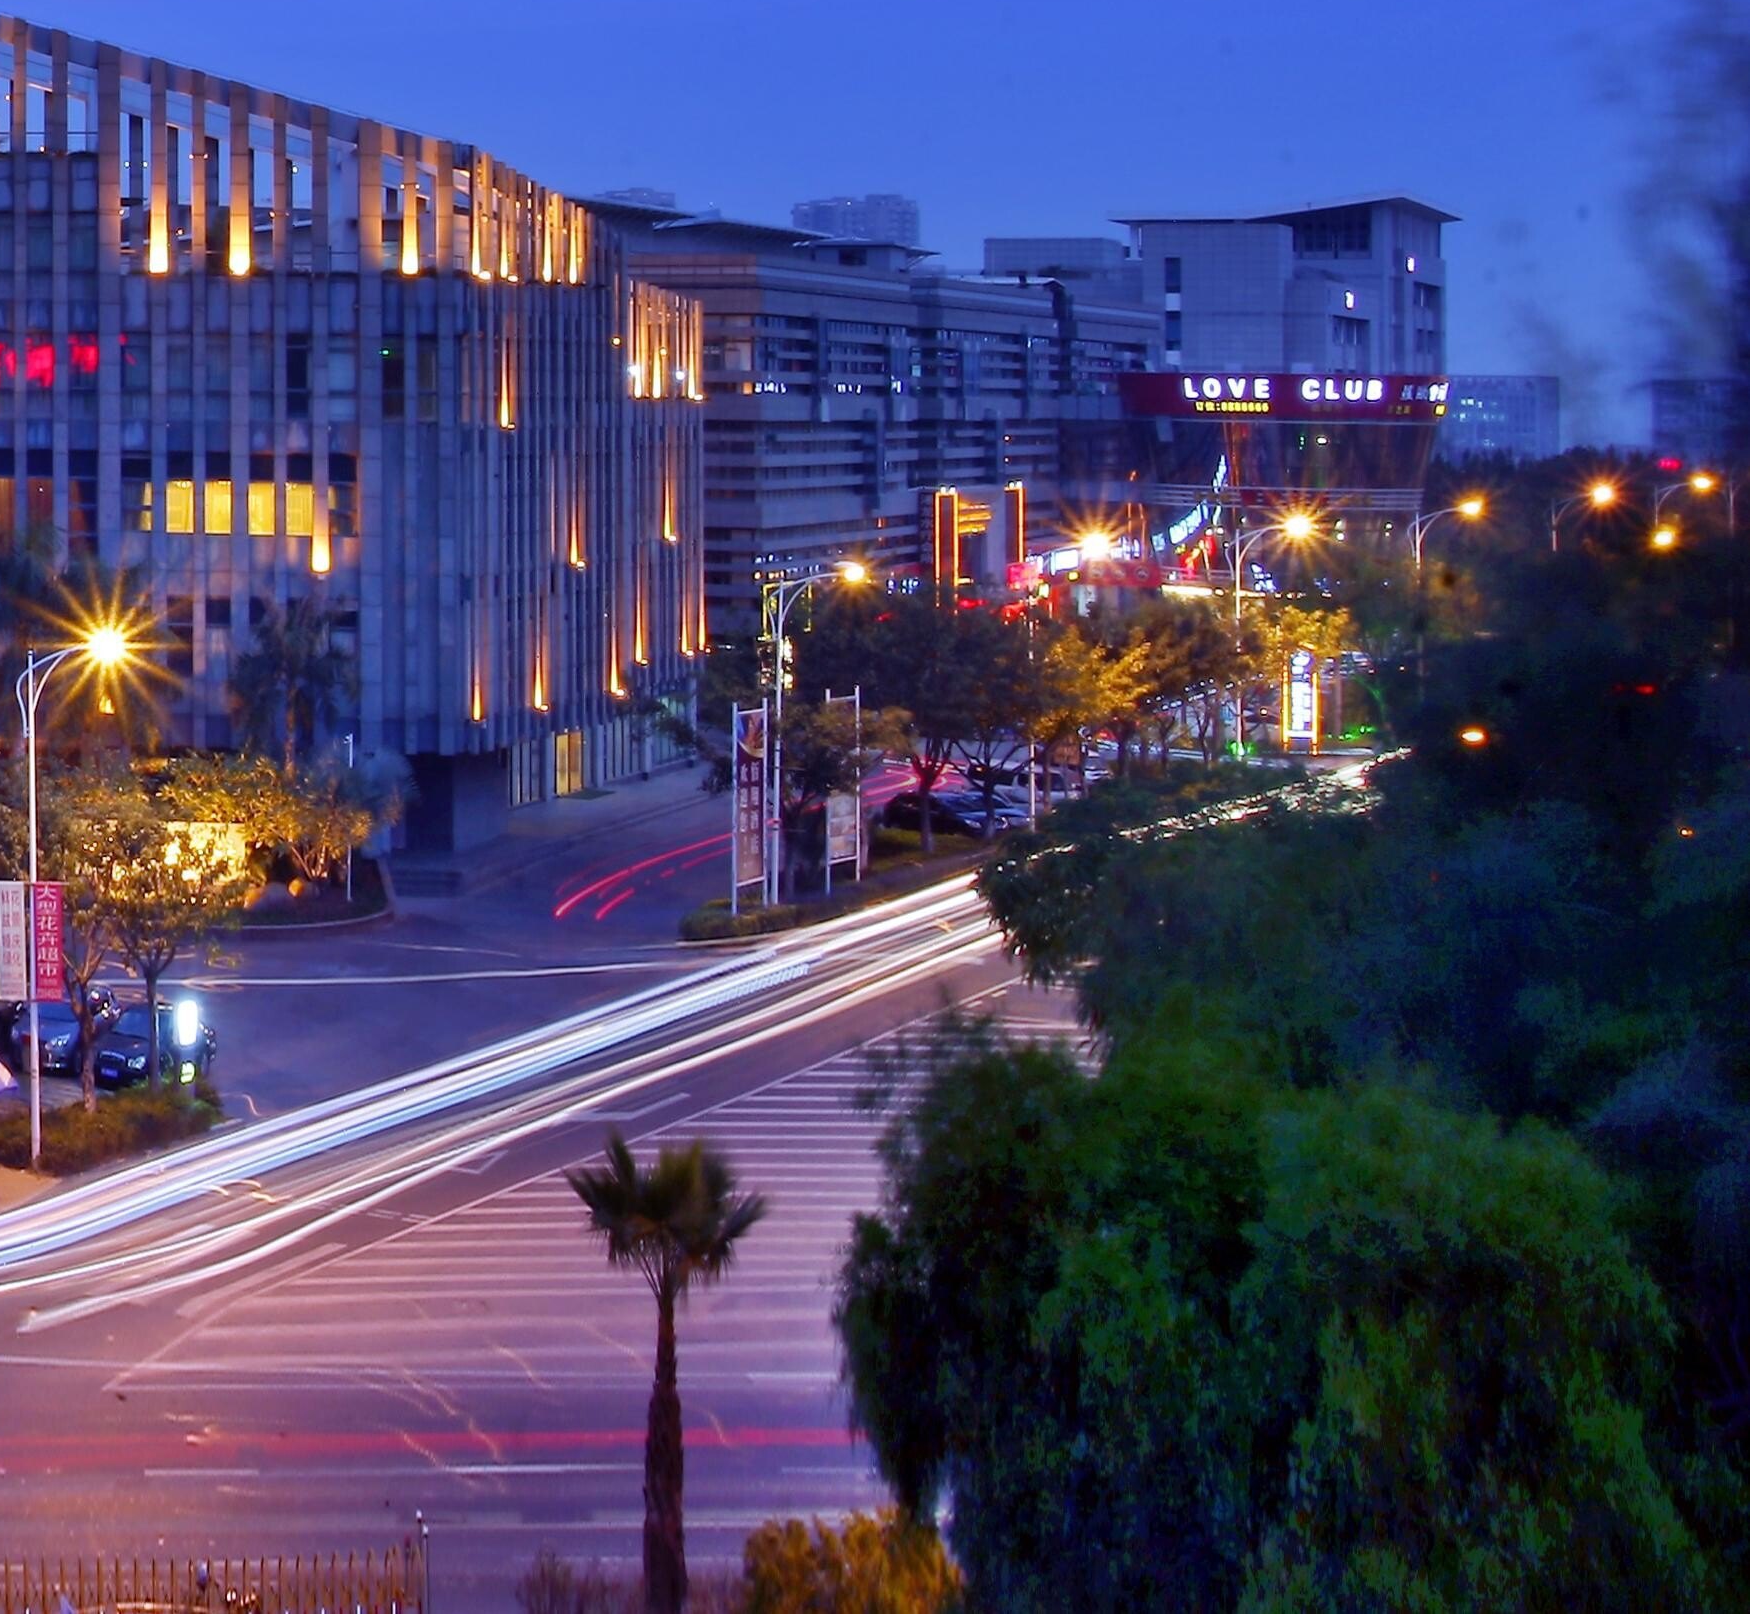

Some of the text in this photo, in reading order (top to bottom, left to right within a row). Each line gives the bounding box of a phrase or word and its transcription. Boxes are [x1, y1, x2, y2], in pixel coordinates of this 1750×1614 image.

[1182, 375, 1271, 400] LOVE
[1300, 378, 1384, 402] CLUB
[36, 884, 59, 977] 大型花卉超市
